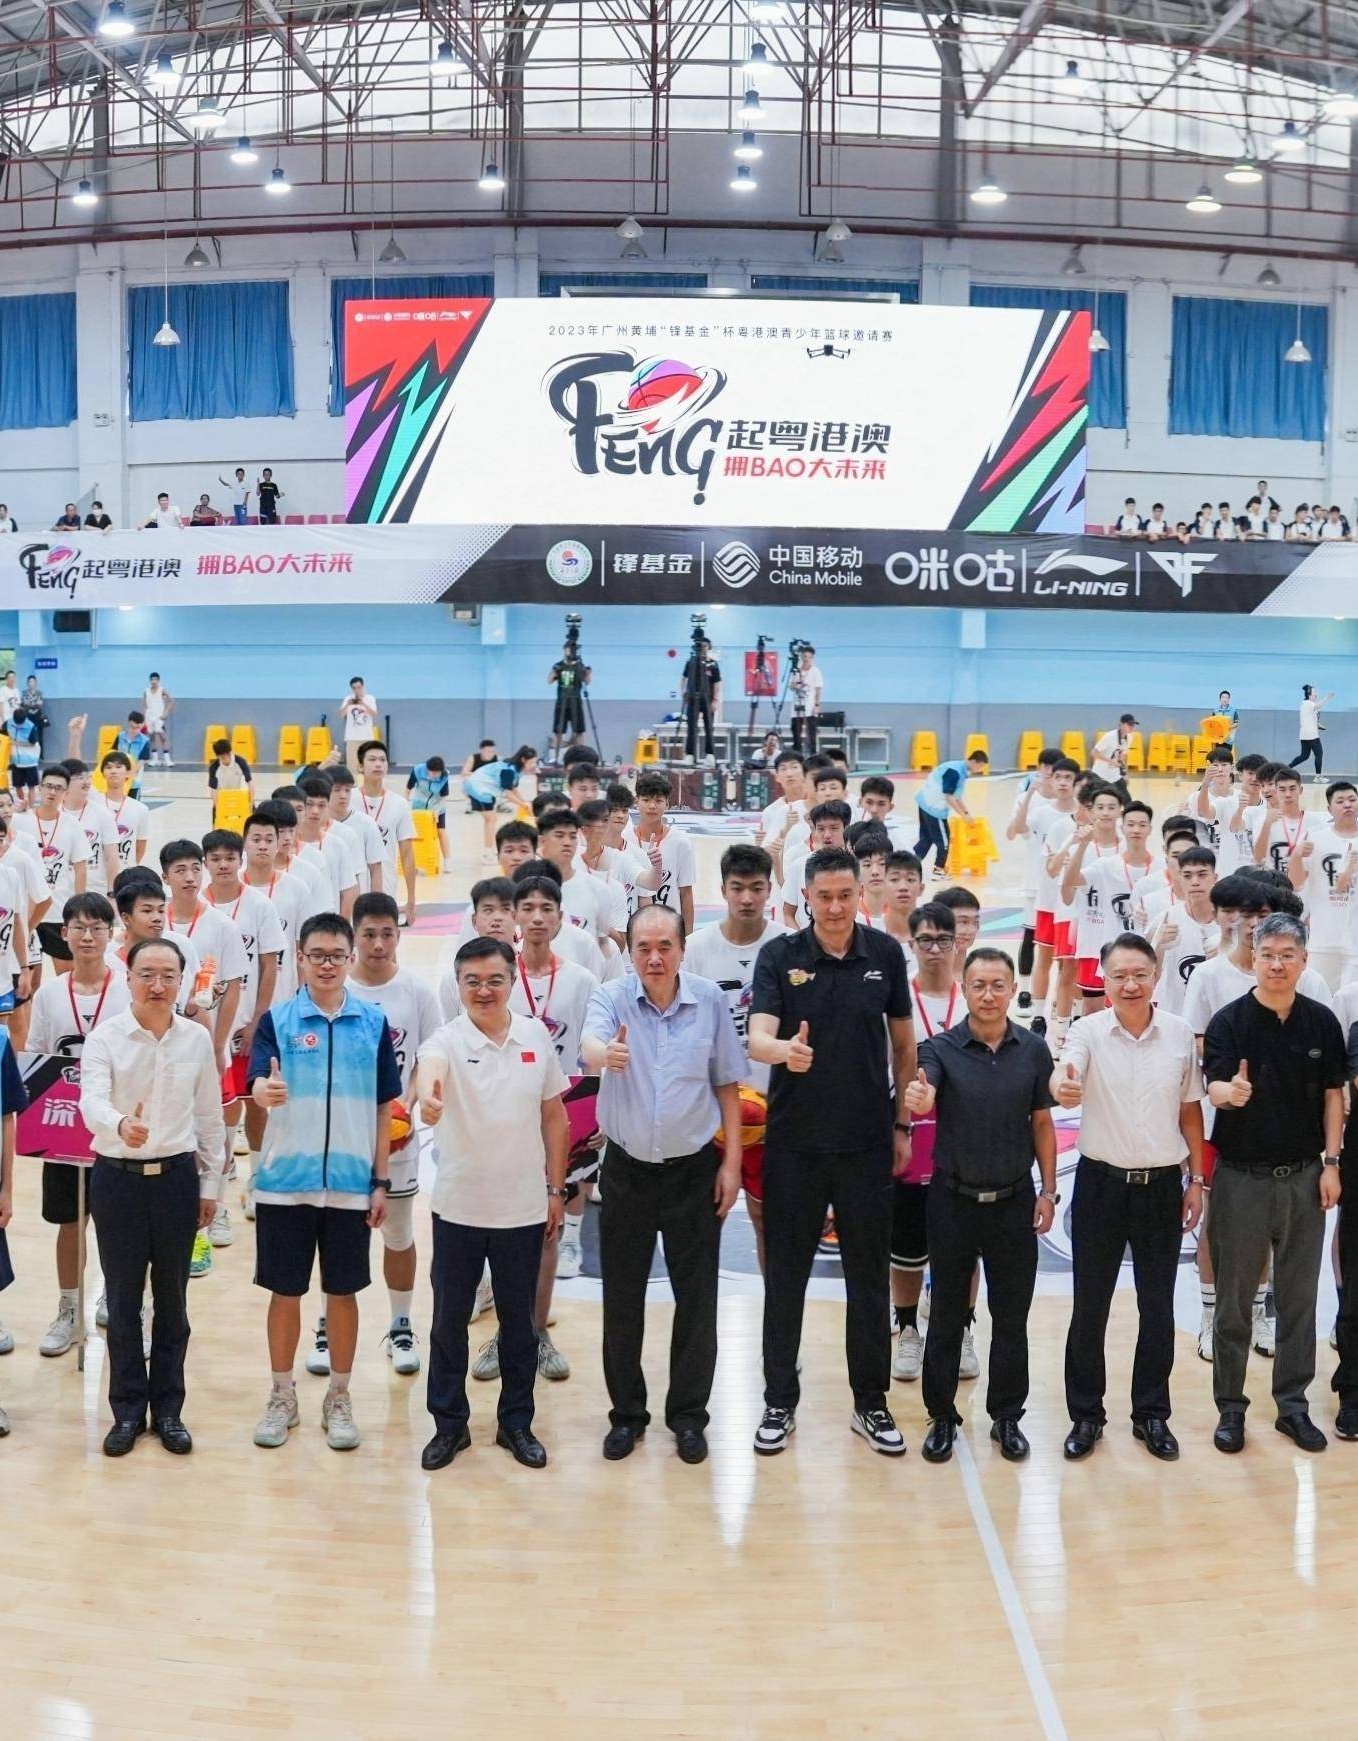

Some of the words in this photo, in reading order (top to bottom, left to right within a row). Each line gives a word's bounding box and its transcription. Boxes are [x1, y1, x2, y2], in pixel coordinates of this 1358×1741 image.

[727, 420, 892, 453] 起粤港澳
[613, 554, 693, 574] 锋基金
[769, 545, 863, 569] 中国移动
[82, 559, 181, 579] 起粤港澳
[769, 570, 811, 586] China
[814, 572, 863, 587] Mobile
[1034, 580, 1129, 596] LI-NING
[42, 1098, 78, 1127] 深
